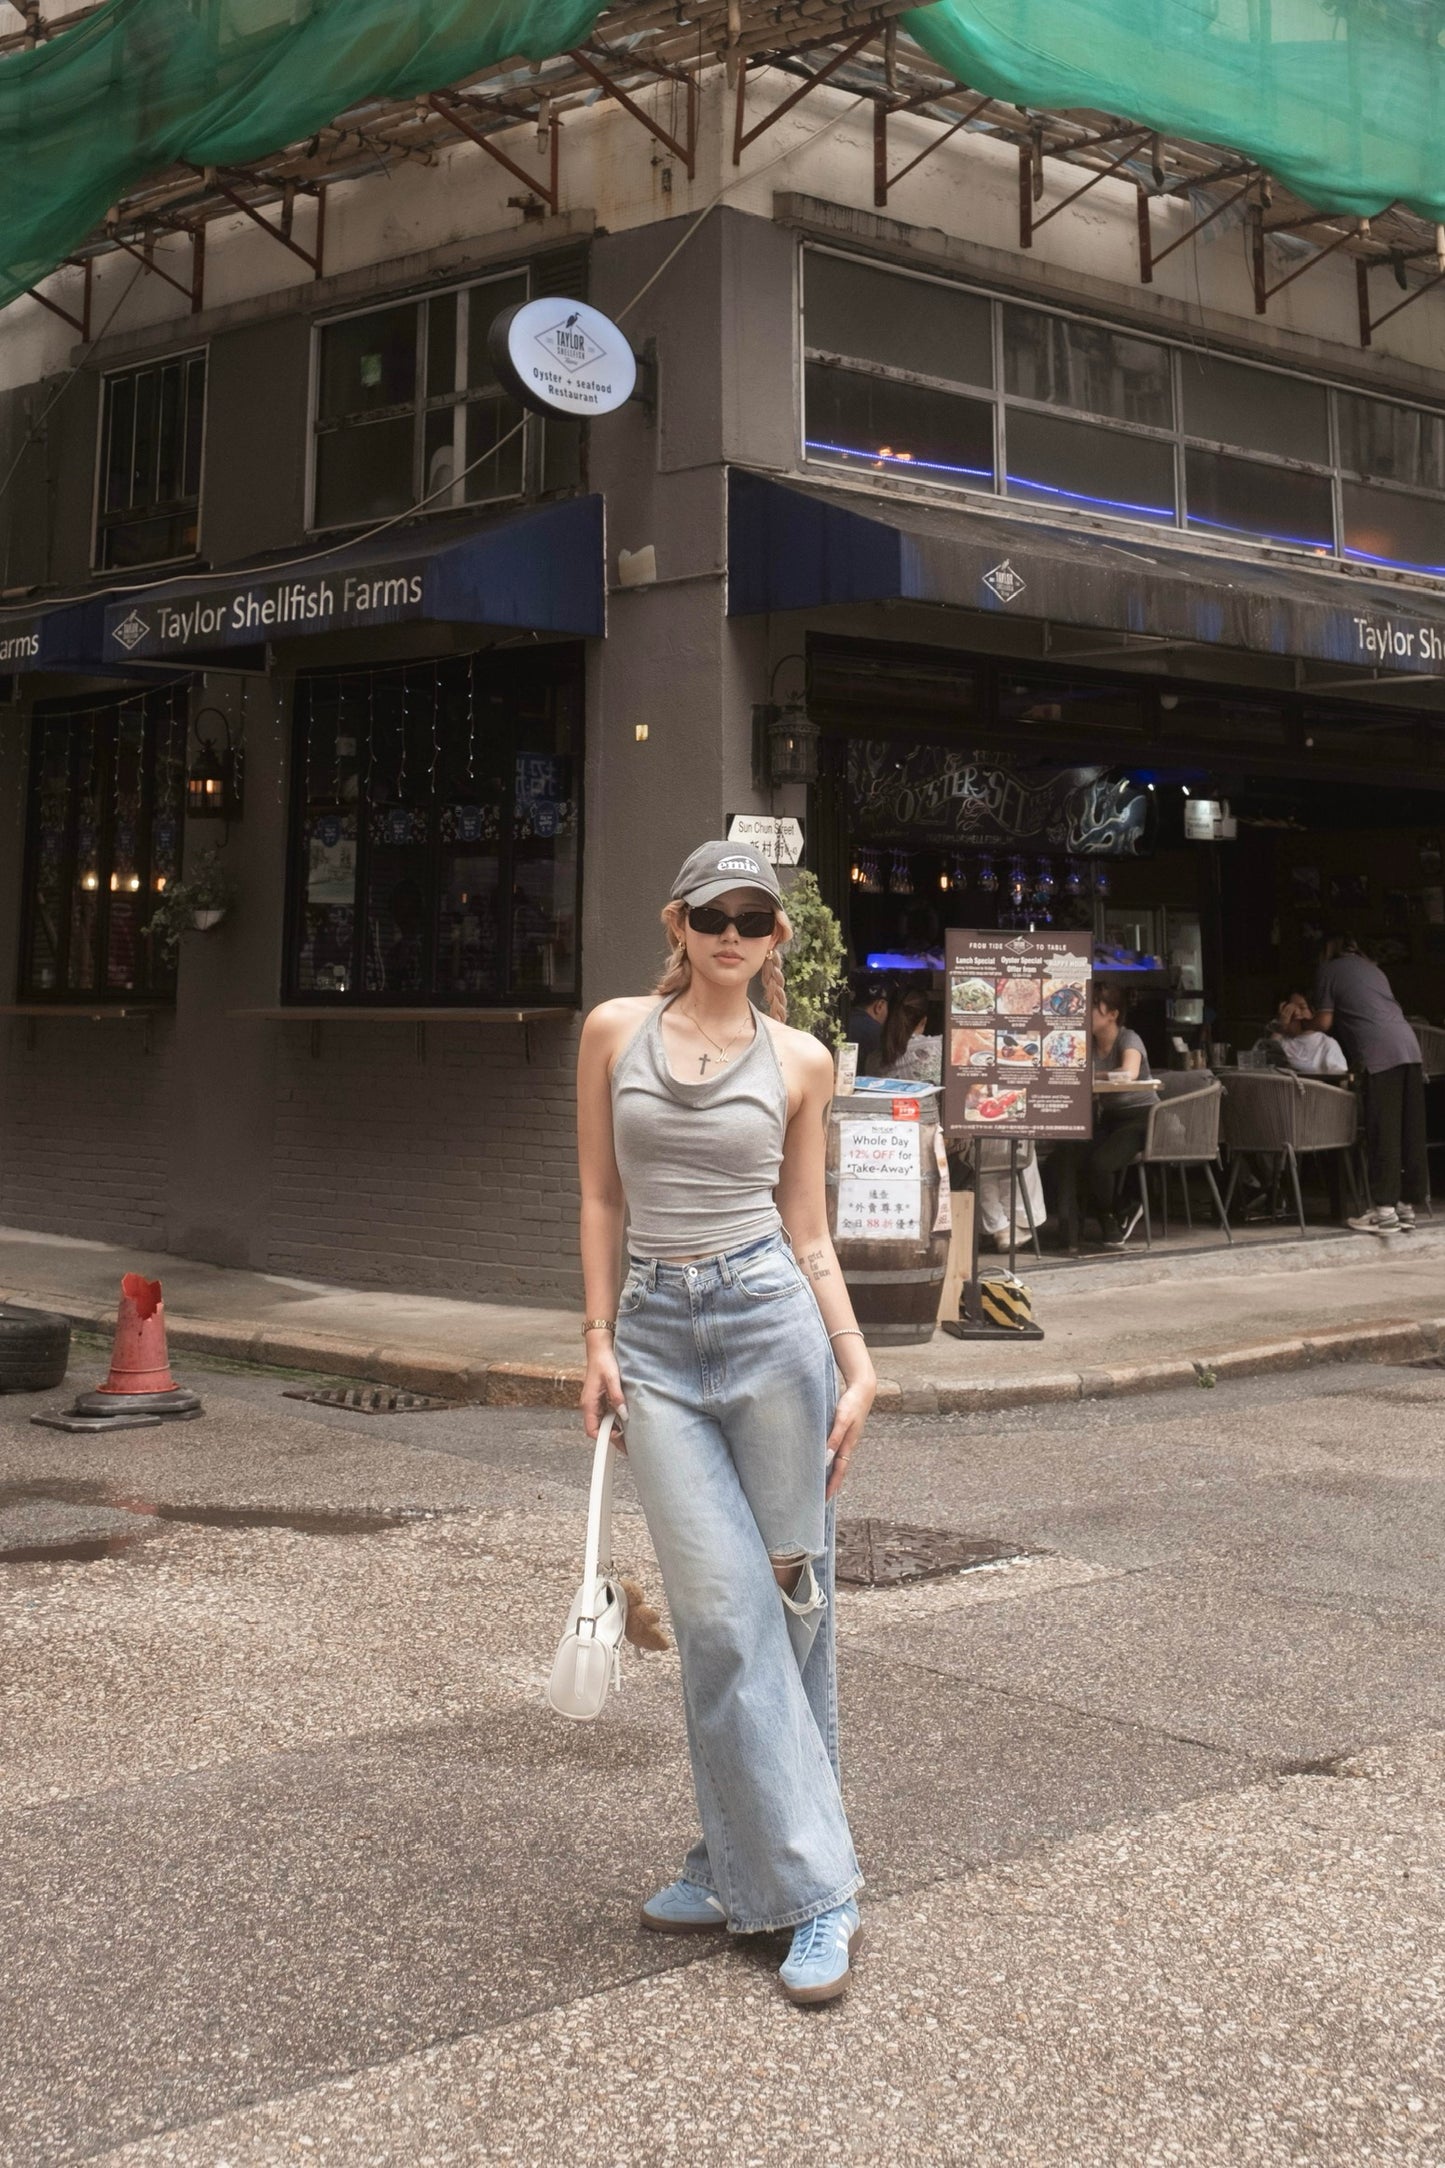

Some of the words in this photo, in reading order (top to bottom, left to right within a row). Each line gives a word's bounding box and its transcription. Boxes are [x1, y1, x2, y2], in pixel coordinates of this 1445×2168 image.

[556, 330, 585, 352] TAYLOR
[533, 367, 562, 384] Oyster
[577, 380, 612, 394] seafood
[548, 385, 598, 404] Restaurant
[157, 601, 226, 644] Taylor
[231, 581, 333, 630] Shellfish
[343, 575, 423, 613] Farms
[1353, 617, 1414, 660] Taylor
[1419, 627, 1445, 660] Sh
[738, 821, 753, 833] Sun
[754, 822, 773, 834] Chun
[774, 822, 795, 836] Sreet
[717, 859, 759, 874] emis
[969, 942, 987, 950] FROM
[989, 942, 1004, 950] TIDE
[1036, 943, 1045, 951] TO
[1047, 943, 1067, 951] TABLE
[853, 1135, 888, 1146] Whole
[891, 1135, 909, 1148] Day
[850, 1150, 869, 1159] 12%
[873, 1149, 896, 1160] OFF
[898, 1150, 912, 1160] for
